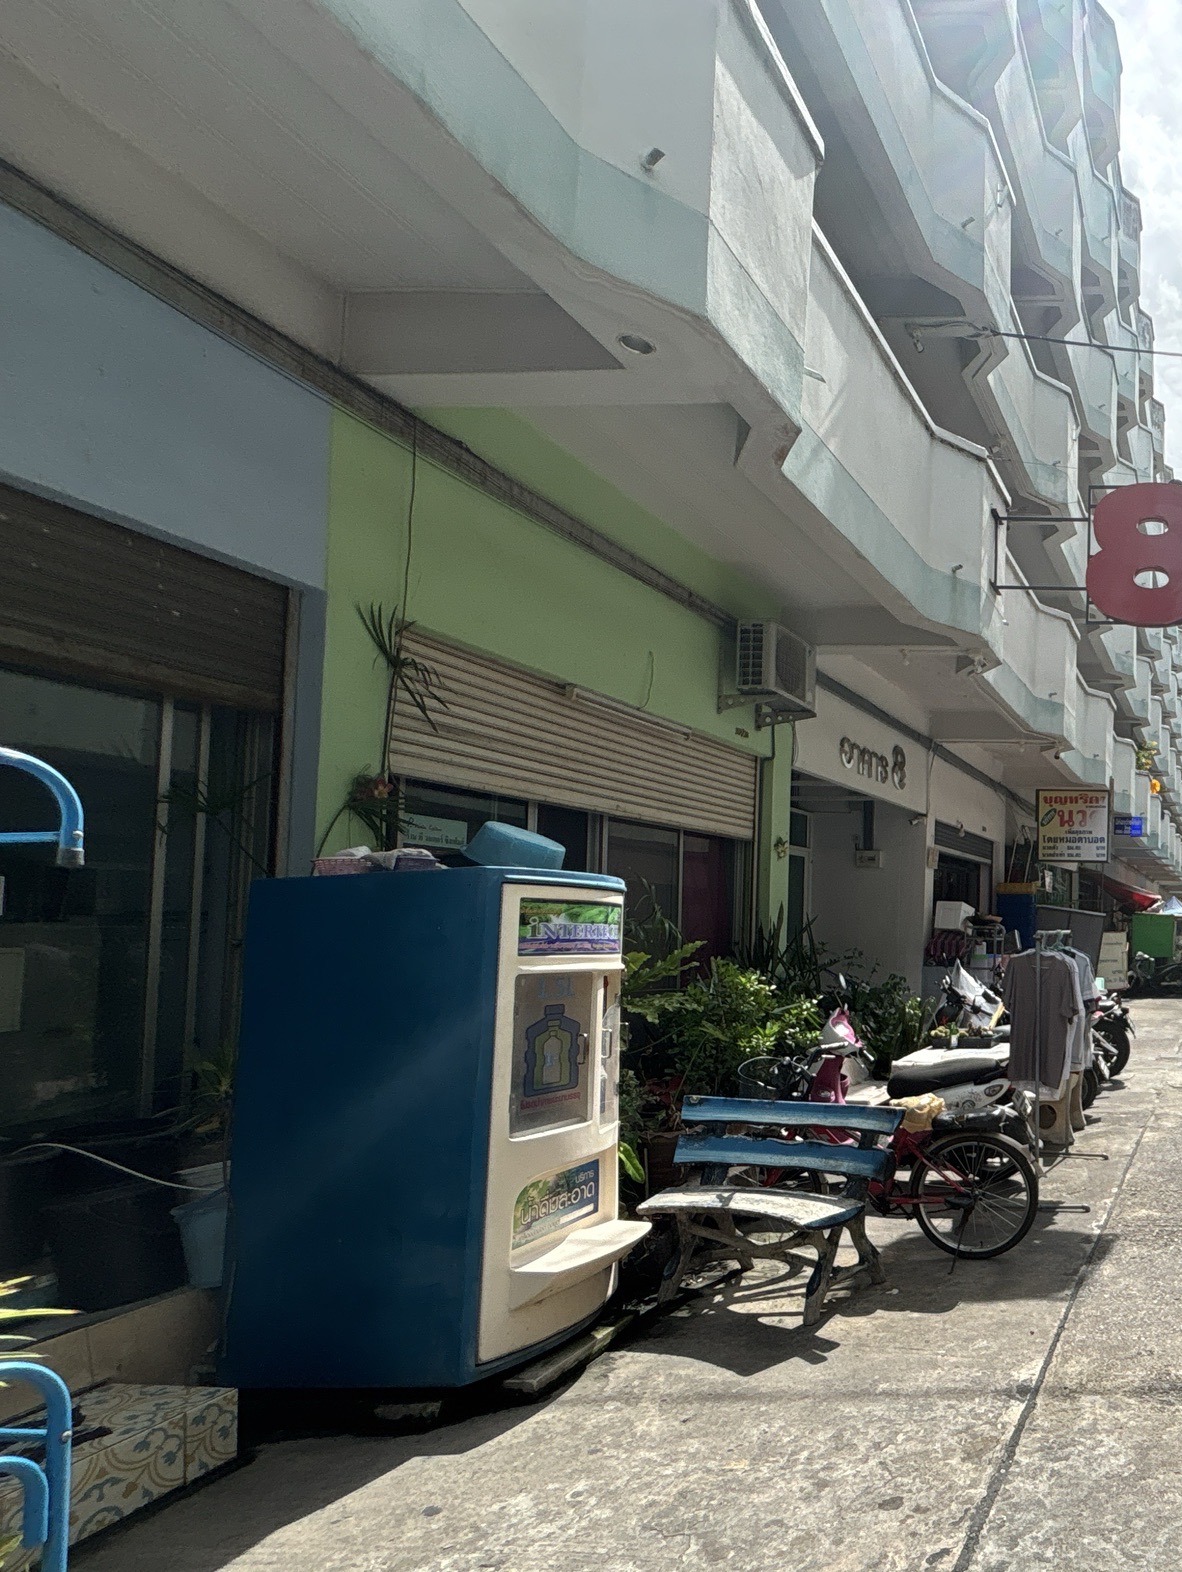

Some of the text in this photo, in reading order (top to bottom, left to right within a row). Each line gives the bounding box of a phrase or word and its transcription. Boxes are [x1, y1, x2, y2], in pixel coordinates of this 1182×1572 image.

[839, 736, 907, 790] อาคาร 8
[1042, 834, 1105, 844] โดยหมอตาบอด
[575, 1169, 595, 1184] บริการ
[521, 1181, 595, 1225] น้ำดื่มสะอาด
